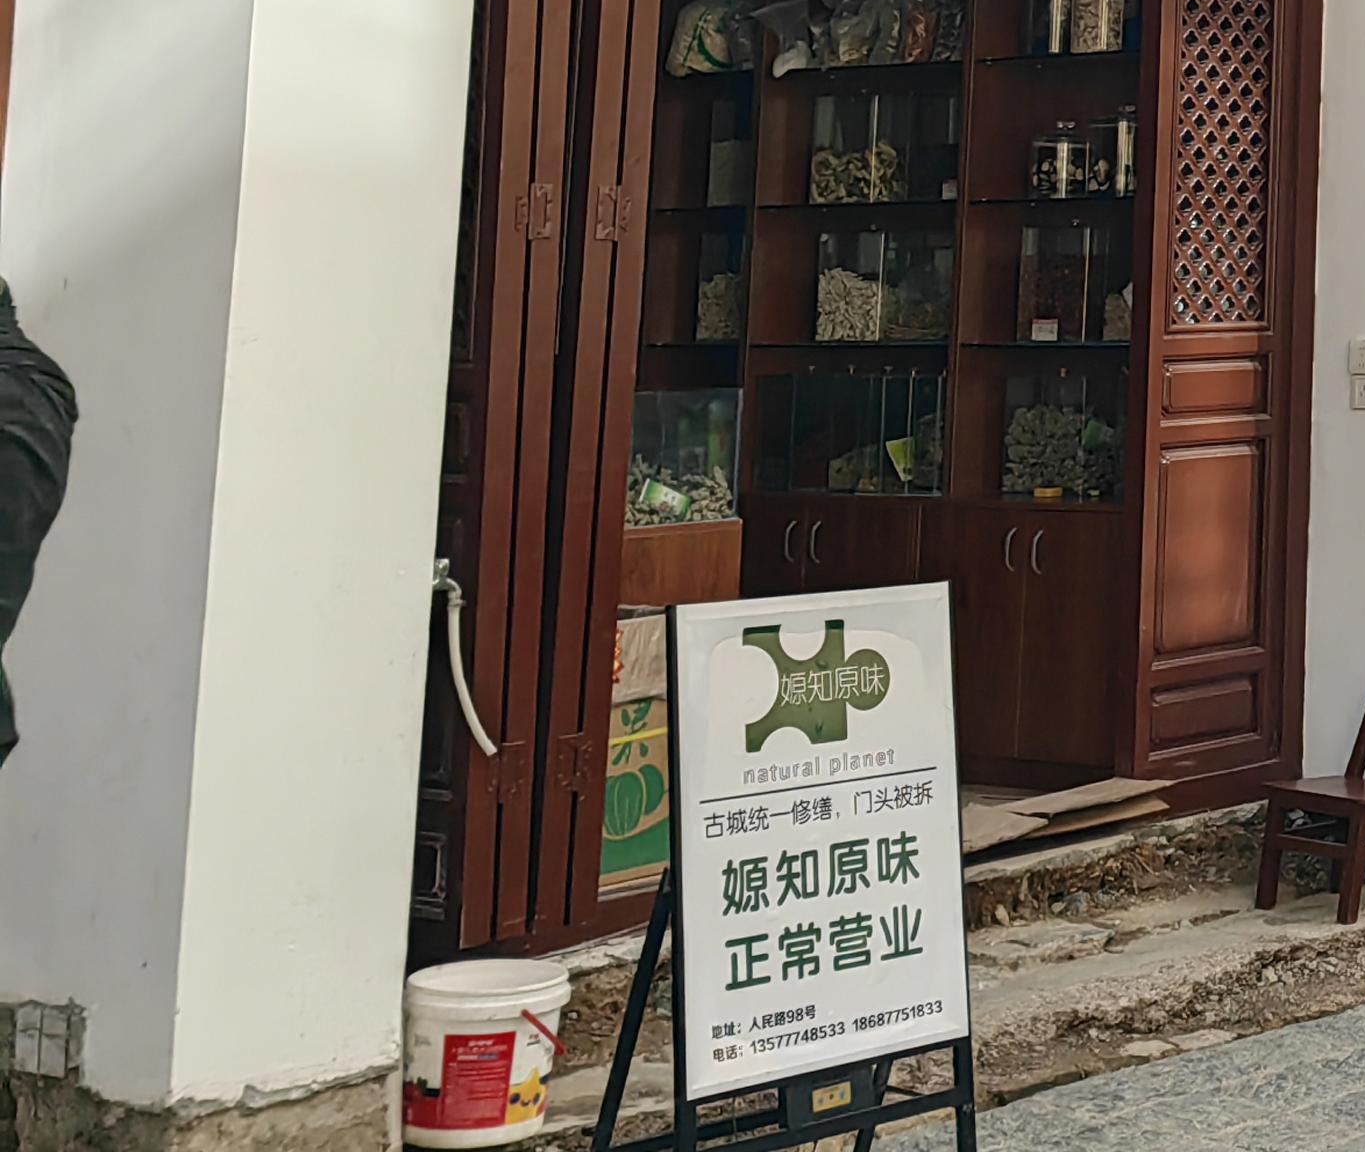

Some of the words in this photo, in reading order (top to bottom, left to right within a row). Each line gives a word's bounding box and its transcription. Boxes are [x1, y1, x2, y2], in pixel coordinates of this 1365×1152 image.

[743, 756, 821, 785] natural
[830, 748, 895, 776] planet
[724, 904, 924, 992] 正常营业
[852, 1000, 943, 1033] 18687751833
